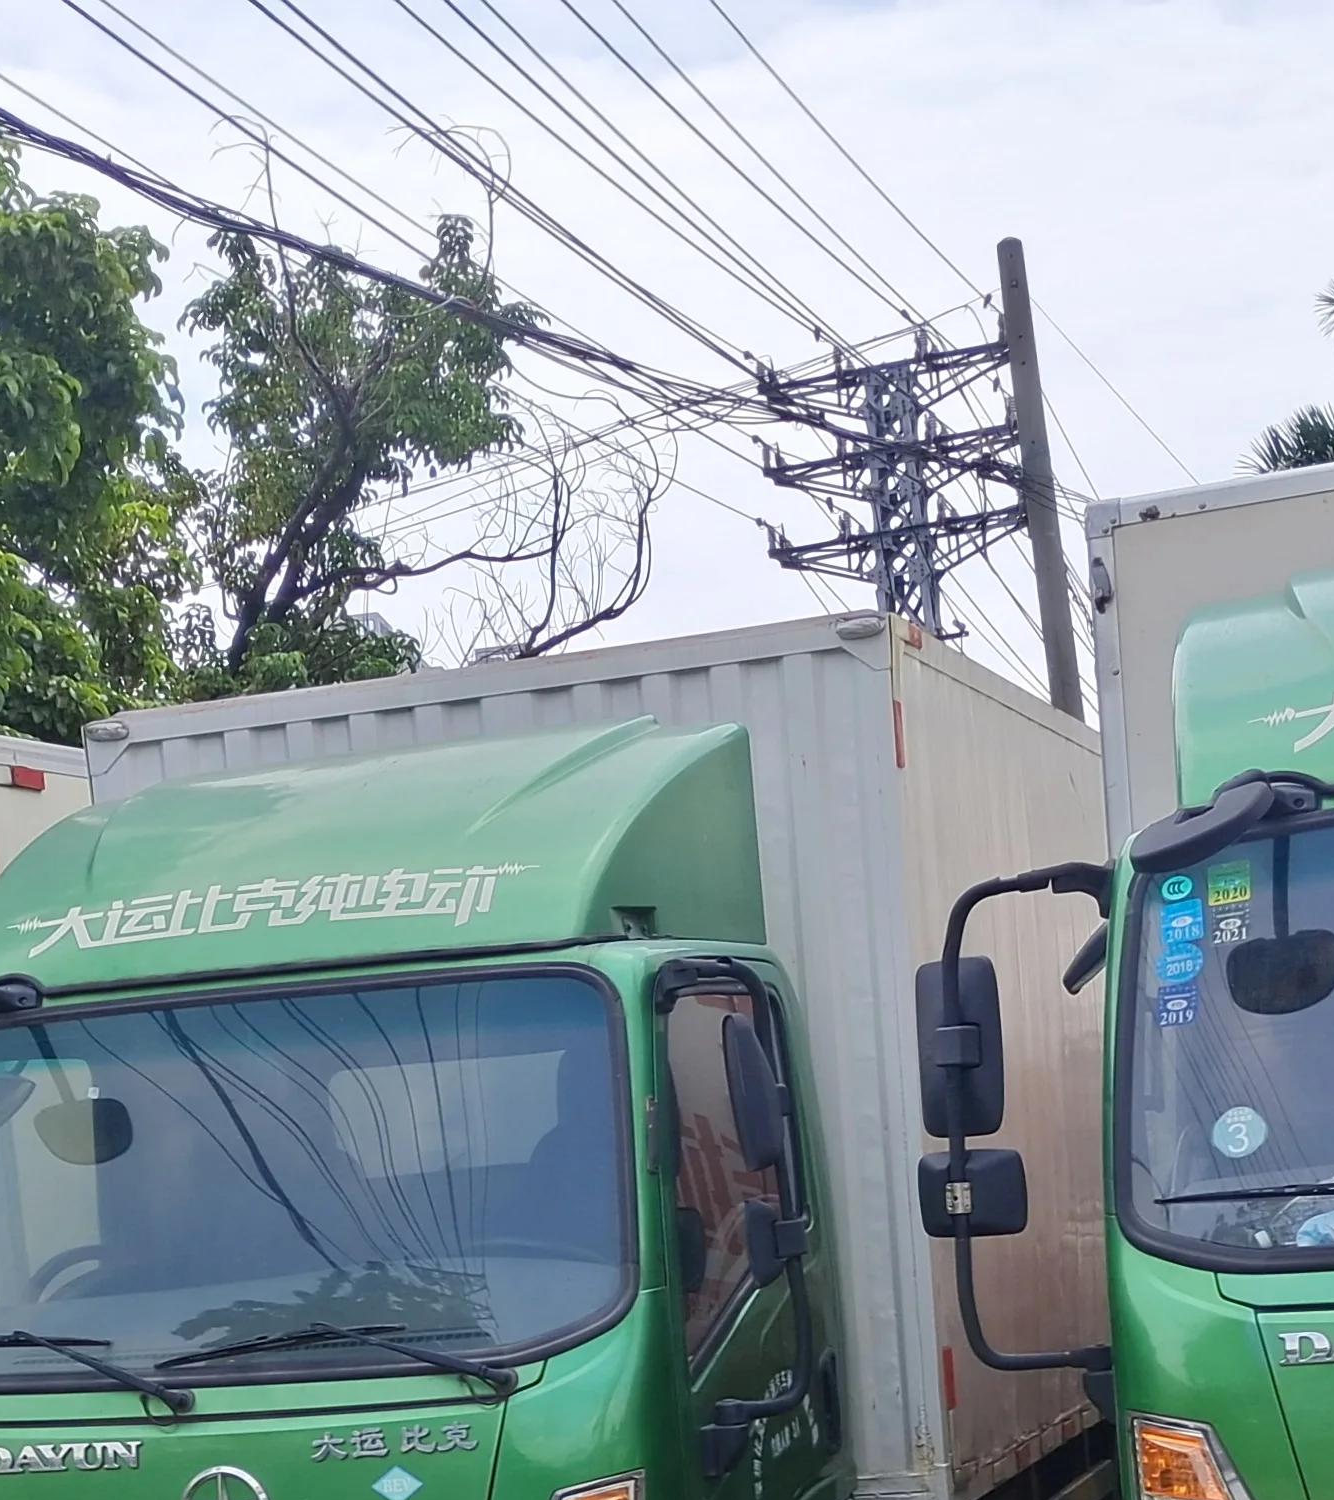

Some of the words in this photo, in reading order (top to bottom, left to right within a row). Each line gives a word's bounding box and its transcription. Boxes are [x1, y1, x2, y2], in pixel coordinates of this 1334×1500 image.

[1213, 886, 1248, 904] 2020
[28, 865, 499, 958] 大运比克纯电动
[1166, 926, 1200, 943] 2018
[1213, 926, 1248, 945] 2021
[1166, 960, 1194, 978] 2018
[1159, 1009, 1195, 1026] 2019
[1227, 1122, 1249, 1153] 3
[381, 1478, 411, 1493] BEV
